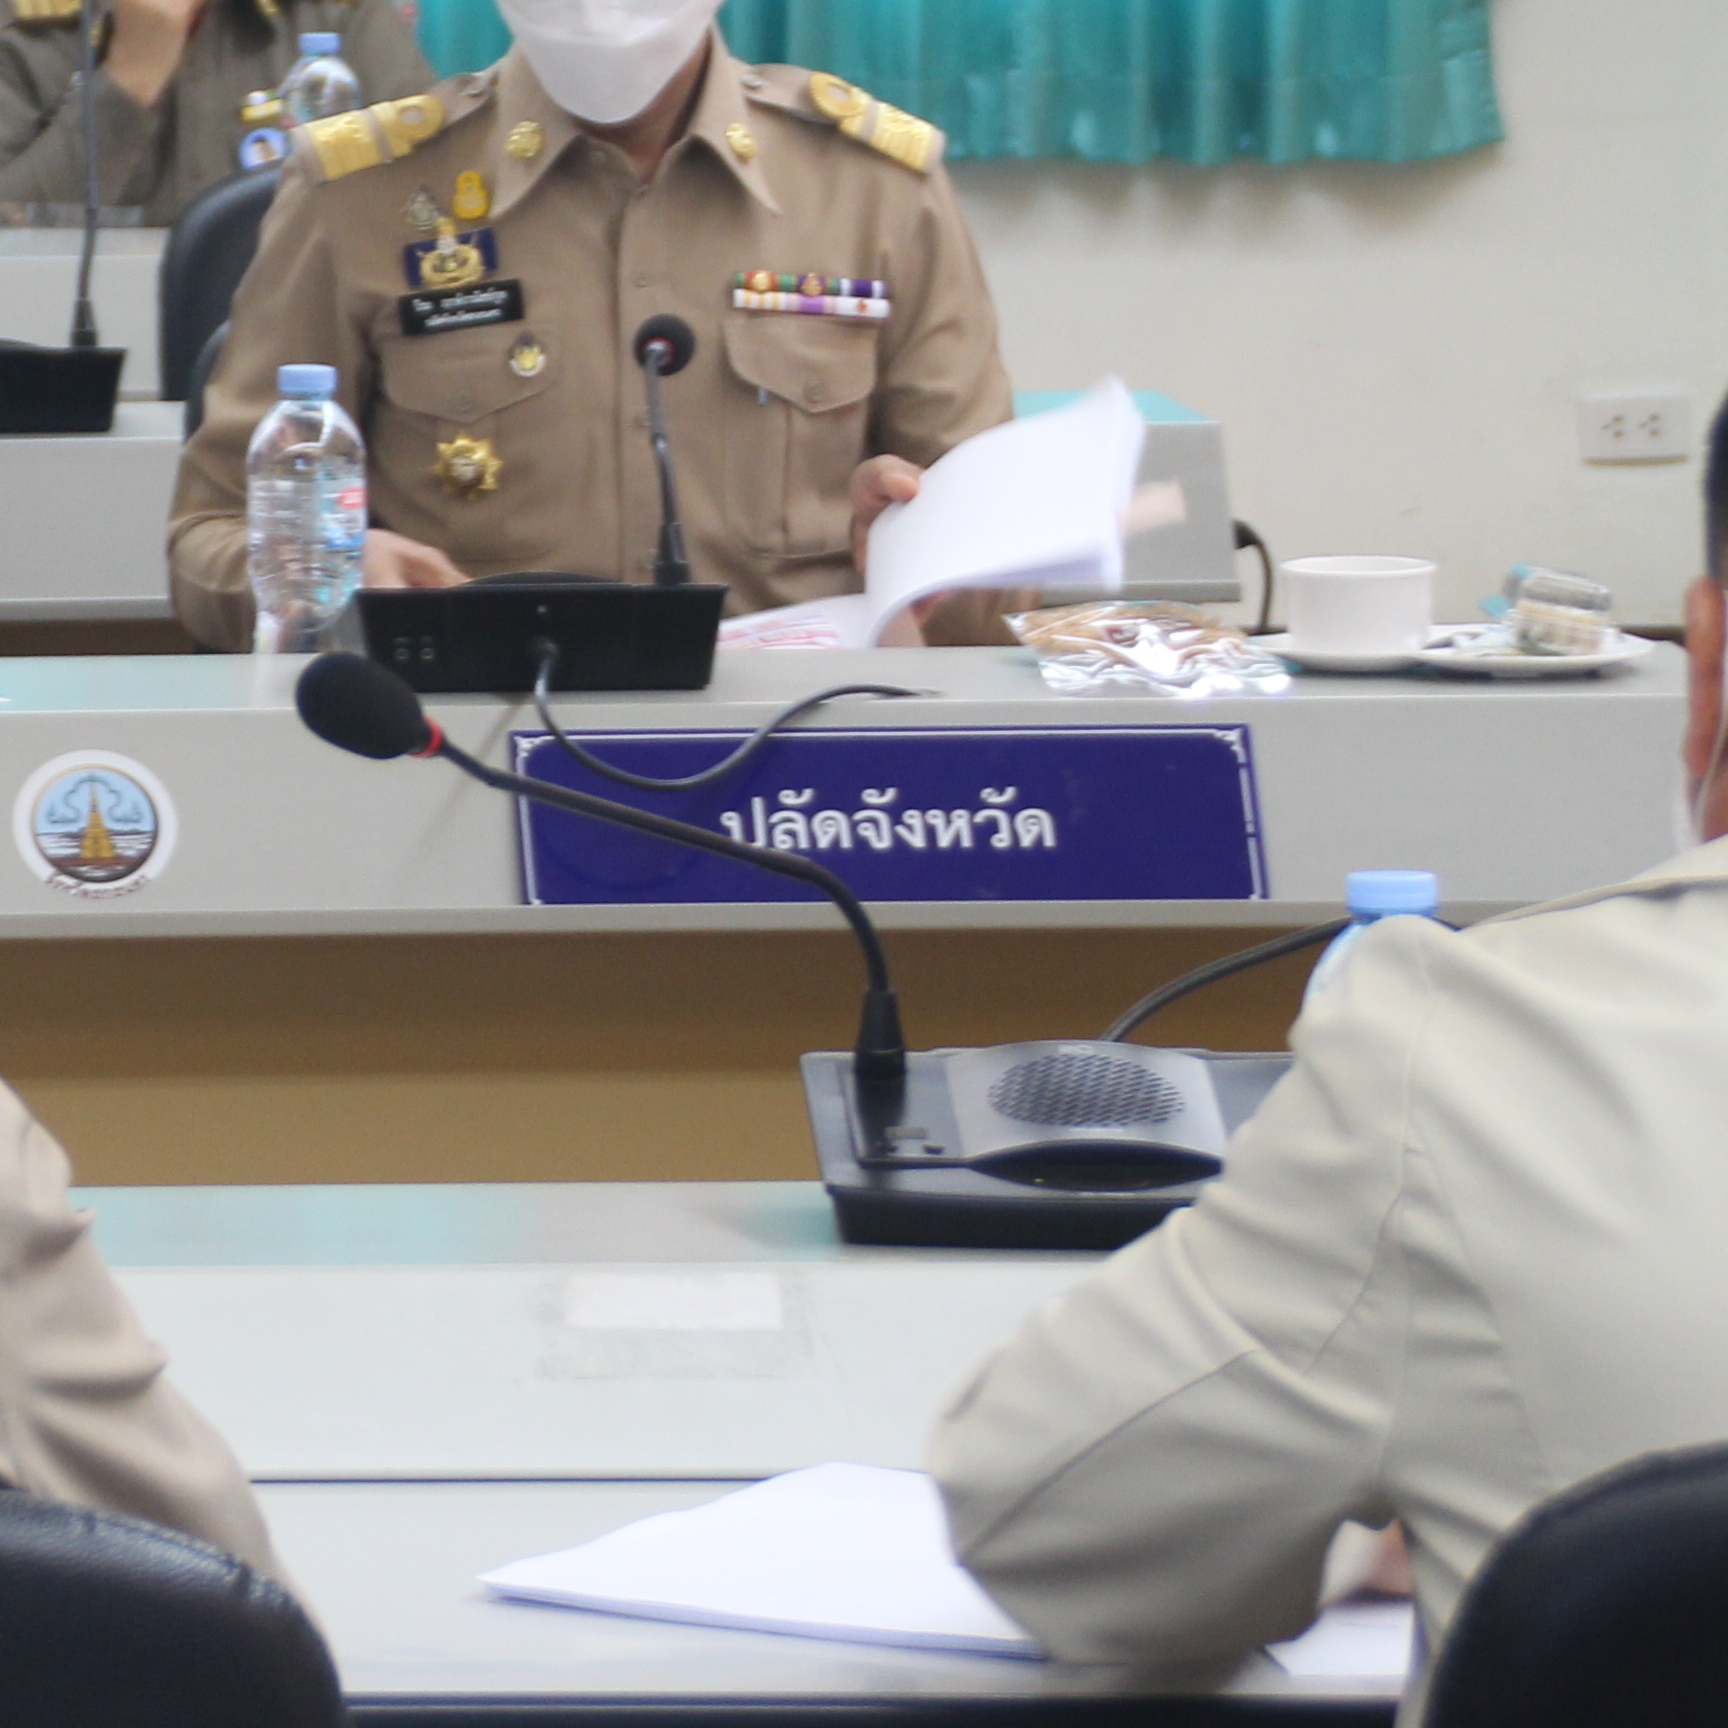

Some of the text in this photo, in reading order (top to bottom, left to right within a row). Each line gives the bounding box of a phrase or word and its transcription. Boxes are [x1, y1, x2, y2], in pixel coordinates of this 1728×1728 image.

[719, 785, 1057, 852] ปลัดจังหวัด
